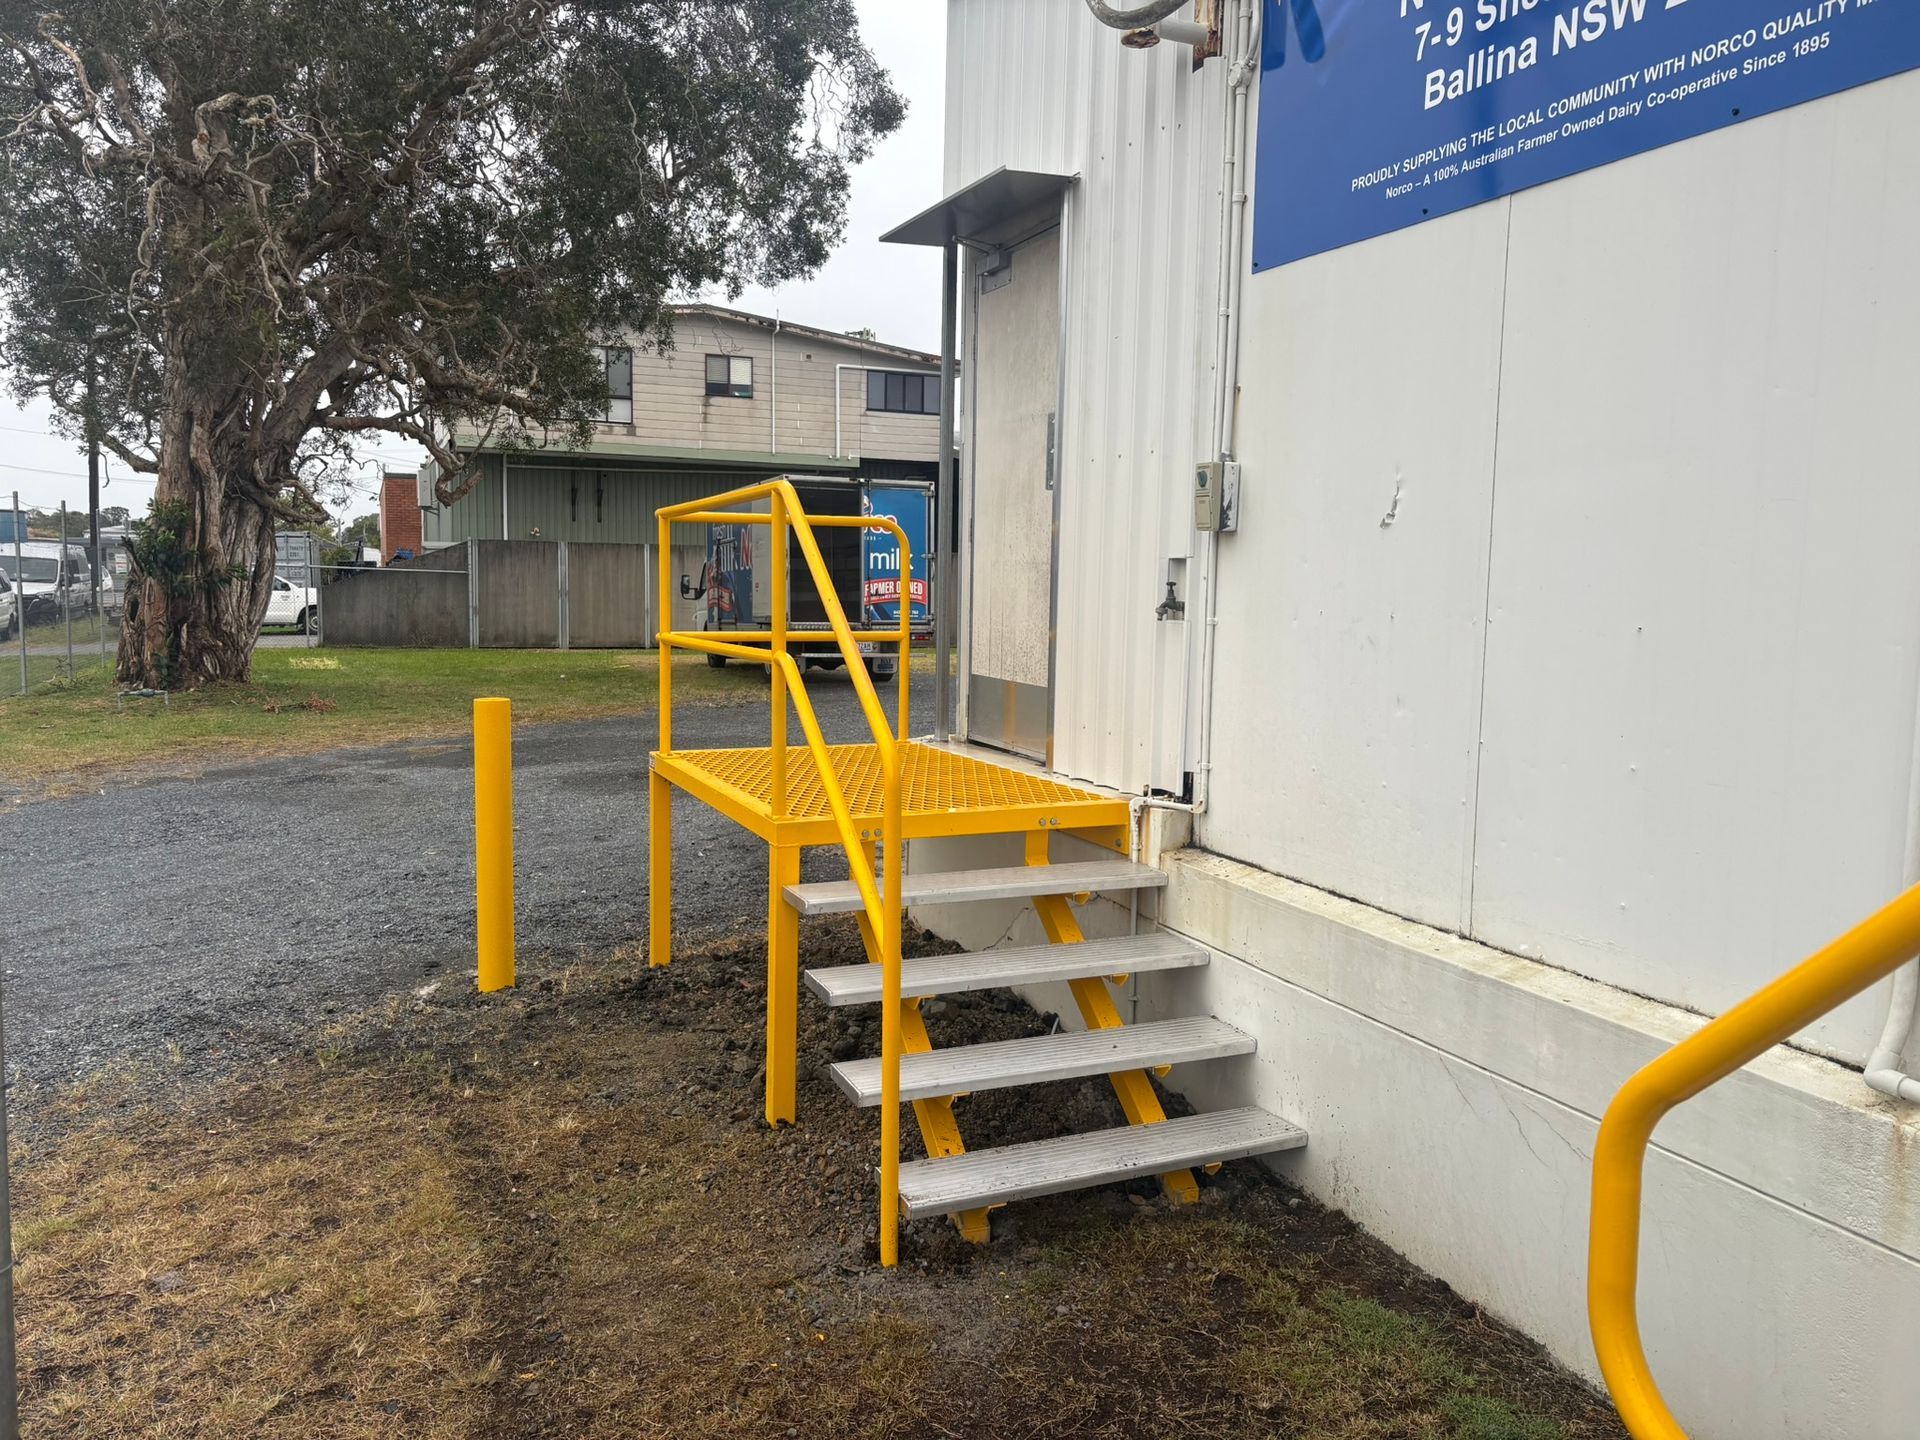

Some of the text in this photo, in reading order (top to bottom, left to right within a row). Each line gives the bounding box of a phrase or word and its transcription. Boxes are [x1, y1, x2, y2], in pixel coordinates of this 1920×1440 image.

[1351, 0, 1850, 192] PROUDLY SUPPLYING THE LOCAL COMMUNITY WITH NORCO QUALITY
[1415, 7, 1464, 62] 7-9
[1424, 0, 1650, 111] Ballina NSW
[1385, 181, 1413, 200] Norco
[1422, 174, 1431, 187] A
[1433, 164, 1459, 183] 100%
[1461, 145, 1514, 174] Australian
[1517, 129, 1558, 153] Farmer
[1561, 111, 1605, 137] Owned
[1608, 100, 1643, 122] Dairy
[1647, 67, 1738, 108] Co-operative
[1743, 50, 1787, 75] Since
[1792, 31, 1831, 59] 1895
